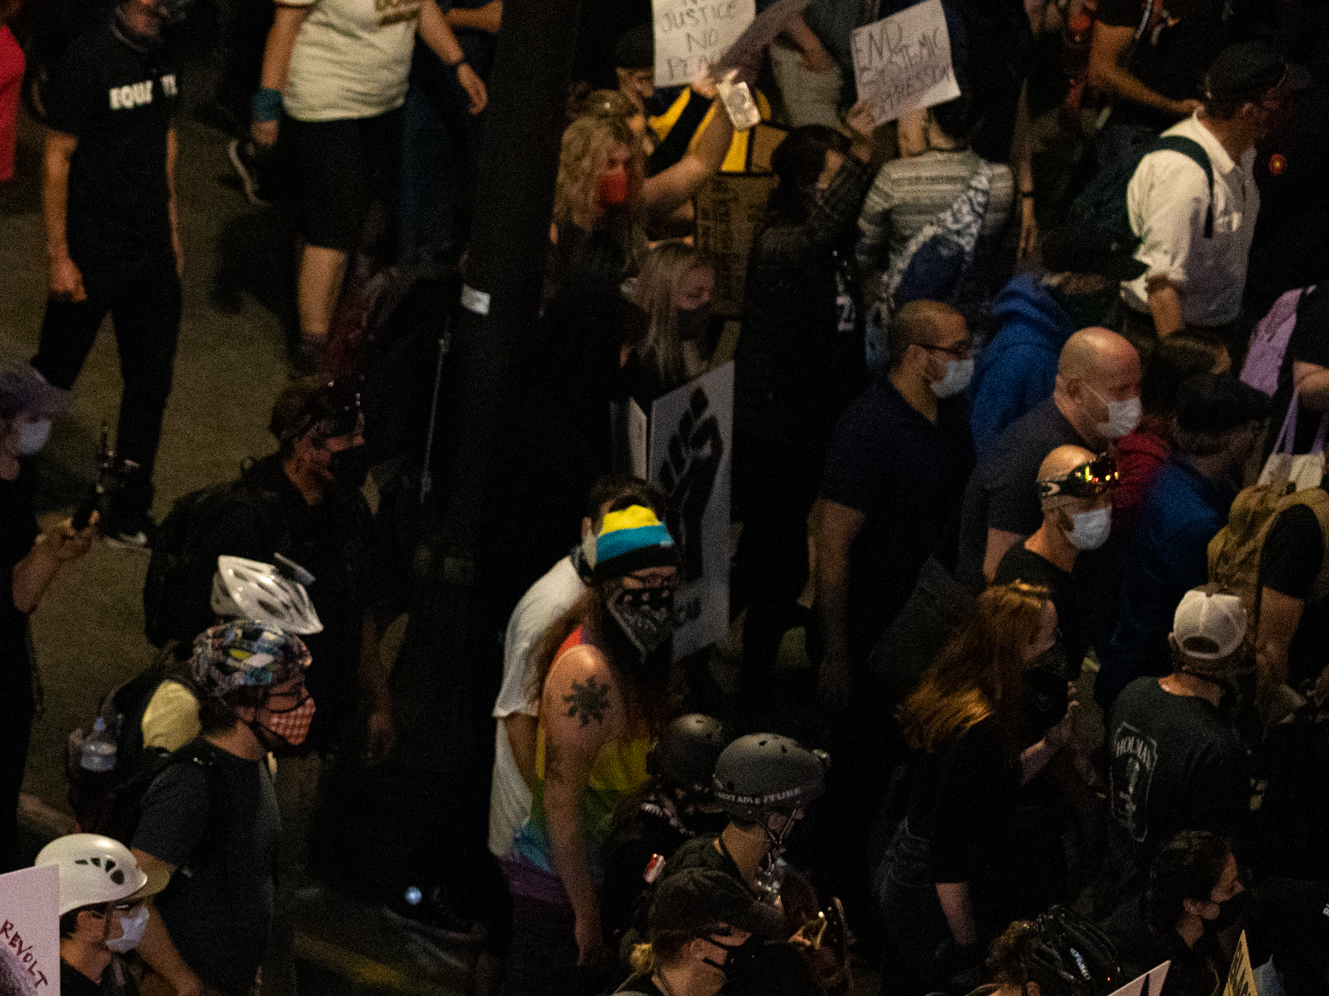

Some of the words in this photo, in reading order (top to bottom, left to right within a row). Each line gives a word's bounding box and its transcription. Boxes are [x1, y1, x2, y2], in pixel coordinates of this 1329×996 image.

[662, 4, 735, 33] JUSTICE
[686, 27, 720, 53] NO
[0, 918, 49, 989] REVOLT
